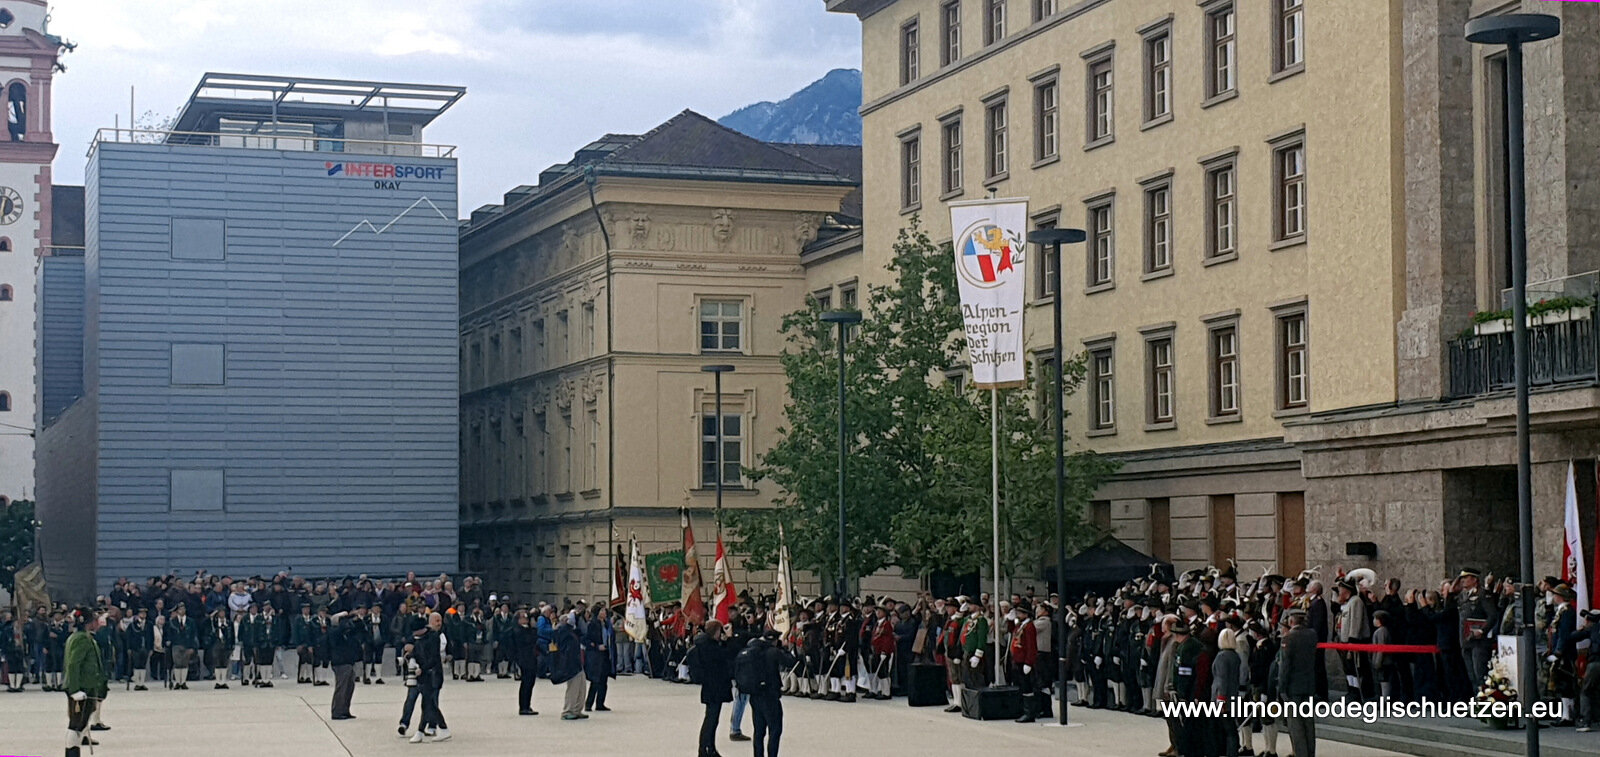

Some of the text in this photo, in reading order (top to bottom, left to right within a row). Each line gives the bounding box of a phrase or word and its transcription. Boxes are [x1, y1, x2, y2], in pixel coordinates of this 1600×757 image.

[345, 162, 444, 179] INTERSPORT
[374, 180, 401, 190] OKAY
[966, 320, 1011, 336] region
[967, 336, 988, 349] der
